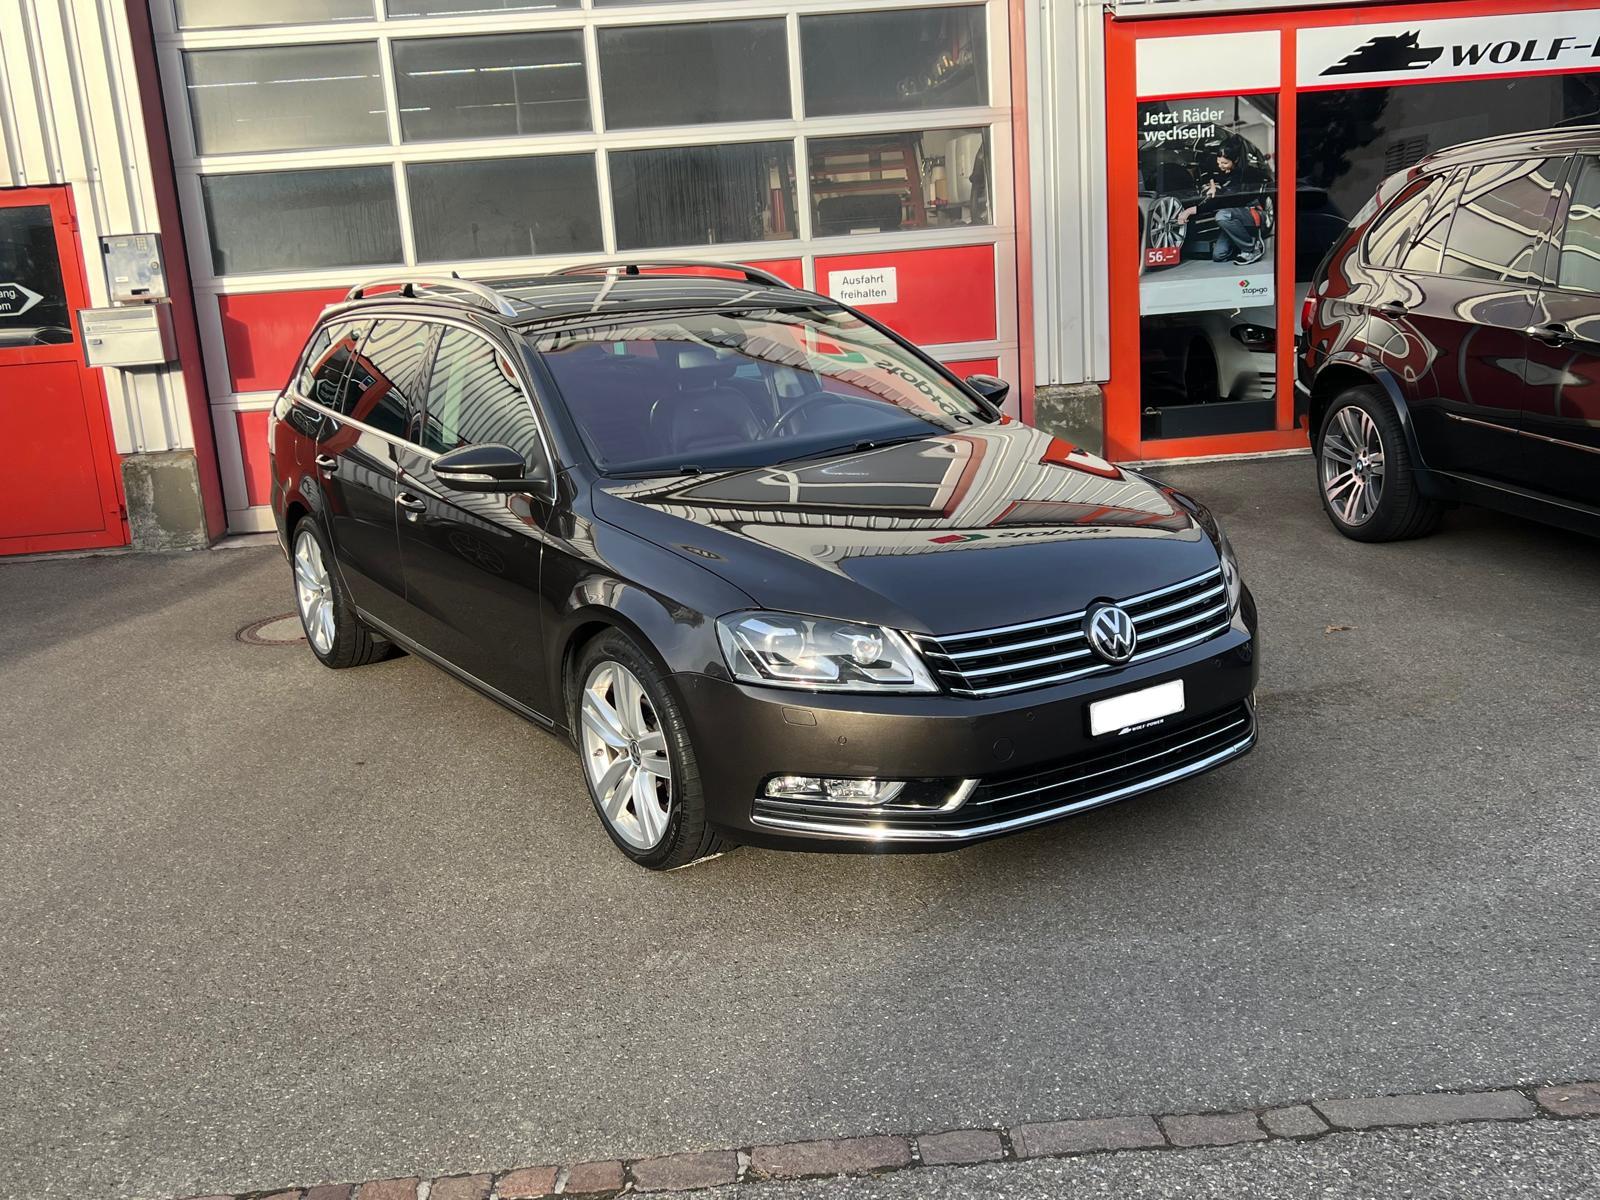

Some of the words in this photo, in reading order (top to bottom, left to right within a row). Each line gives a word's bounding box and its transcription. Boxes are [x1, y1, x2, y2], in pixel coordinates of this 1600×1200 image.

[1143, 111, 1179, 126] Jetzt
[1182, 107, 1225, 123] Räder
[1143, 124, 1215, 142] wechseln!
[842, 274, 884, 286] Ausfahrt
[840, 288, 887, 299] freihalten
